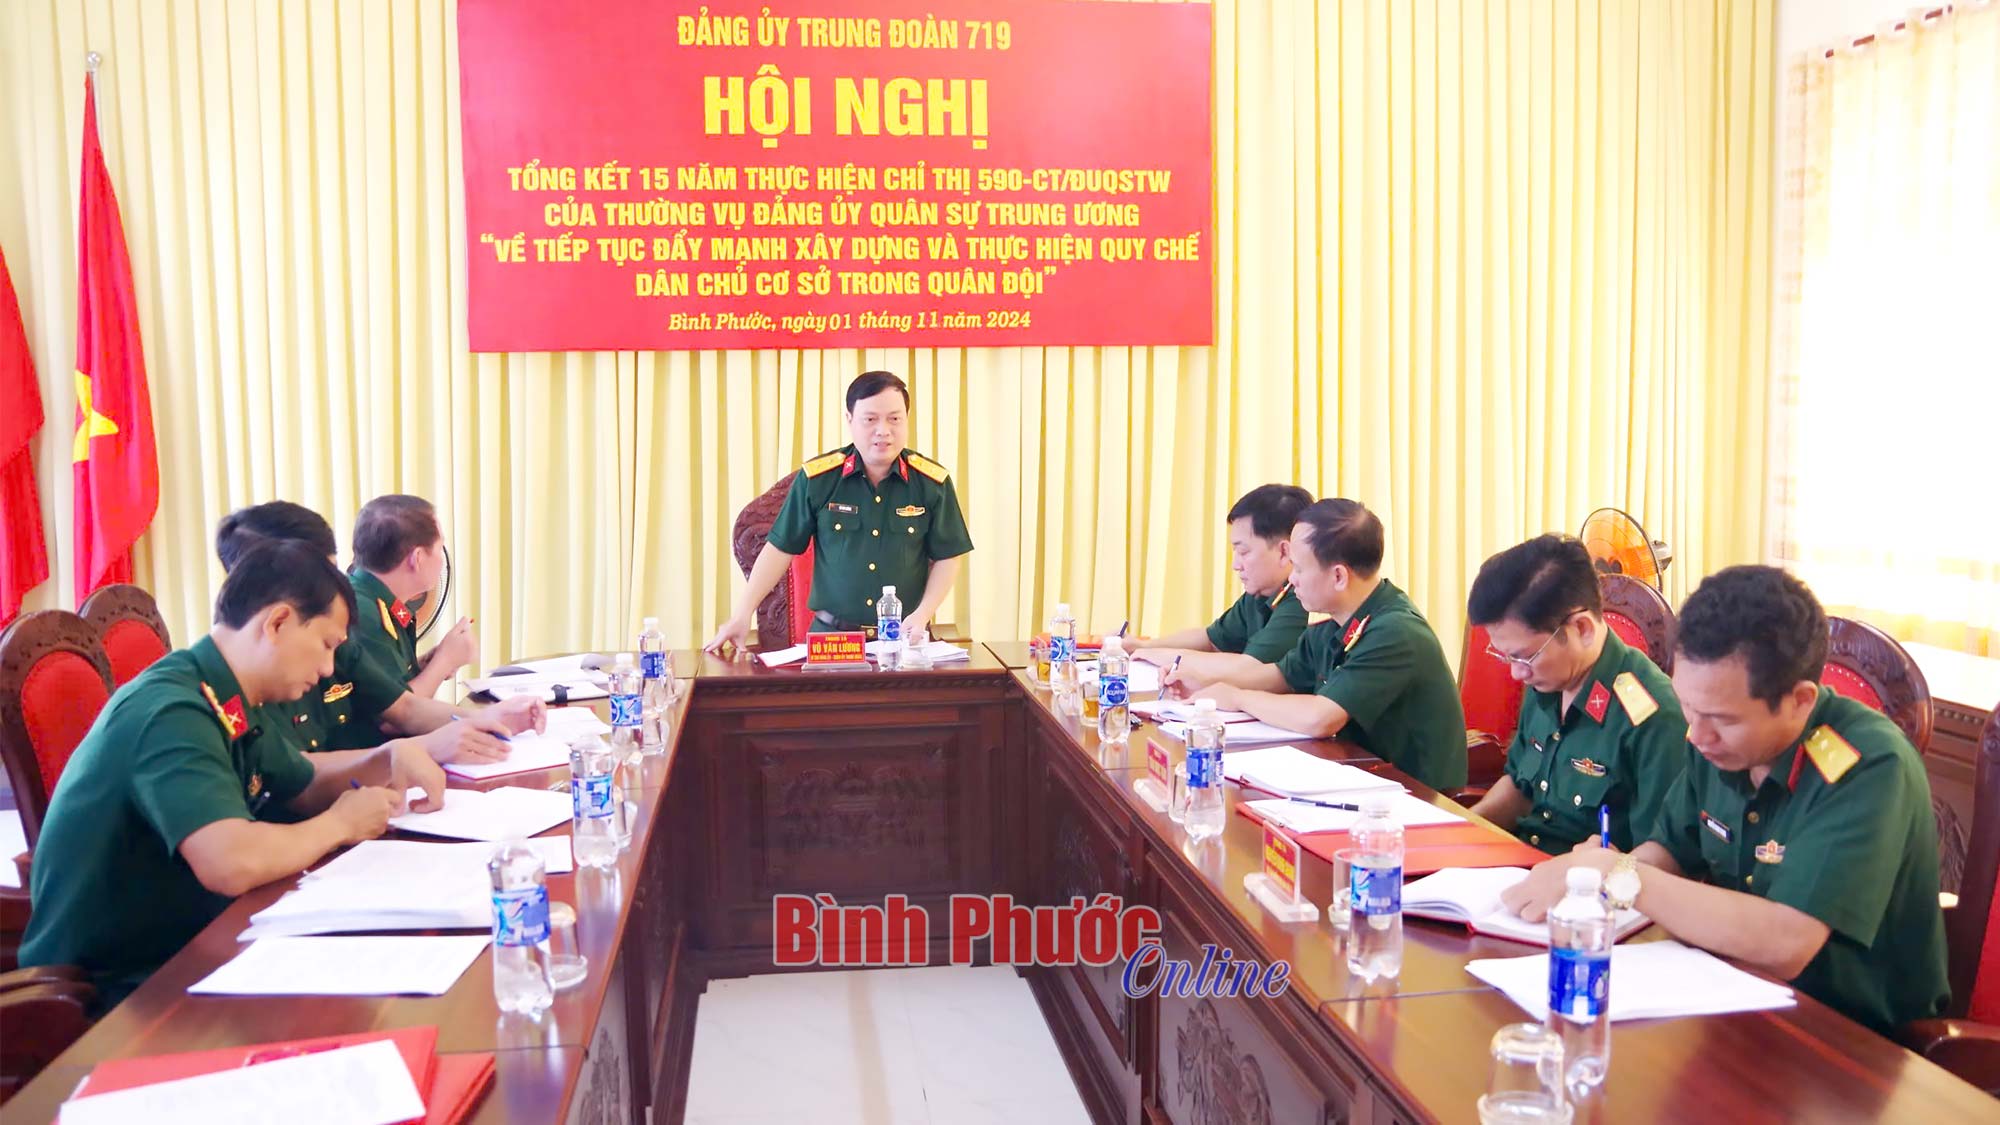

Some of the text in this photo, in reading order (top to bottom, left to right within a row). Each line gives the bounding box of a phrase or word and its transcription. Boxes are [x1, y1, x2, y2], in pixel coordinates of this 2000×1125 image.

[677, 6, 1012, 51] ĐẢNG ỦY TRUNG ĐOÀN 719
[703, 64, 989, 150] HỘI NGHỊ
[507, 159, 1172, 196] TỔNG KẾT 15 NĂM THỰC HIỆN CHỈ THỊ 590-CT/ĐUQSTW
[544, 195, 1140, 230] CỦA THƯỜNG VỤ ĐẢNG ỦY QUÂN SỰ TRUNG ƯƠNG
[480, 229, 1201, 266] “VỀ TIẾP TỤC ĐẨY MẠNH XÂY DỰNG VÀ THỰC HIỆN QUY CHẾ
[636, 264, 1057, 299] DÂN CHỦ CƠ SỞ TRONG QUÂN ĐỘI”
[668, 311, 1031, 333] Bình Phước, ngày 01 tháng 11 năm 2024
